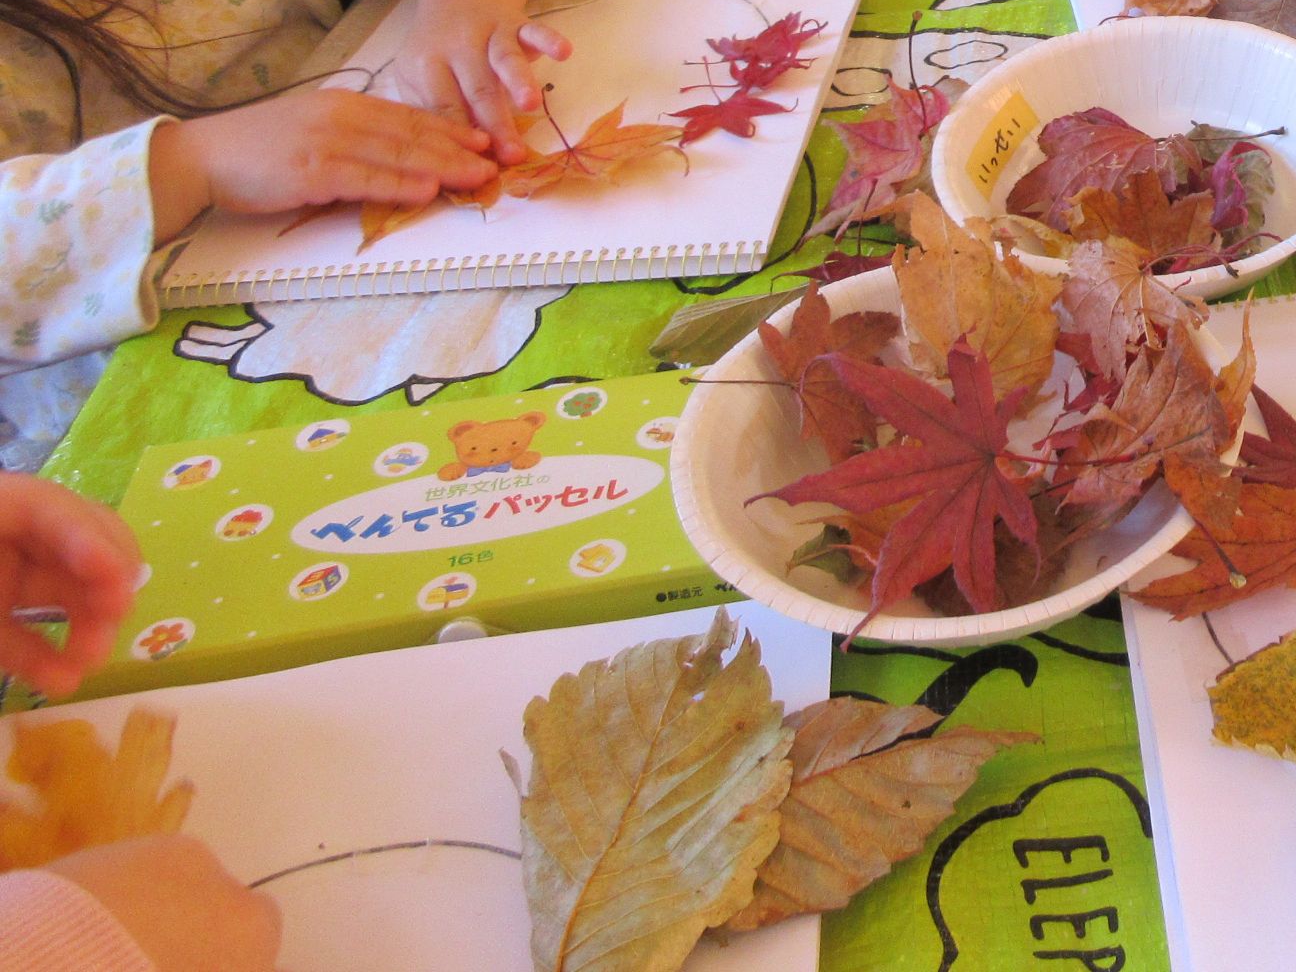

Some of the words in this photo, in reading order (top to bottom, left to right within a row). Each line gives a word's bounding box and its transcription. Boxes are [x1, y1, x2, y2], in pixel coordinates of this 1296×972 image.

[425, 473, 550, 502] 世界文化社の
[447, 549, 494, 568] 16色
[1012, 835, 1126, 972] ELEP
